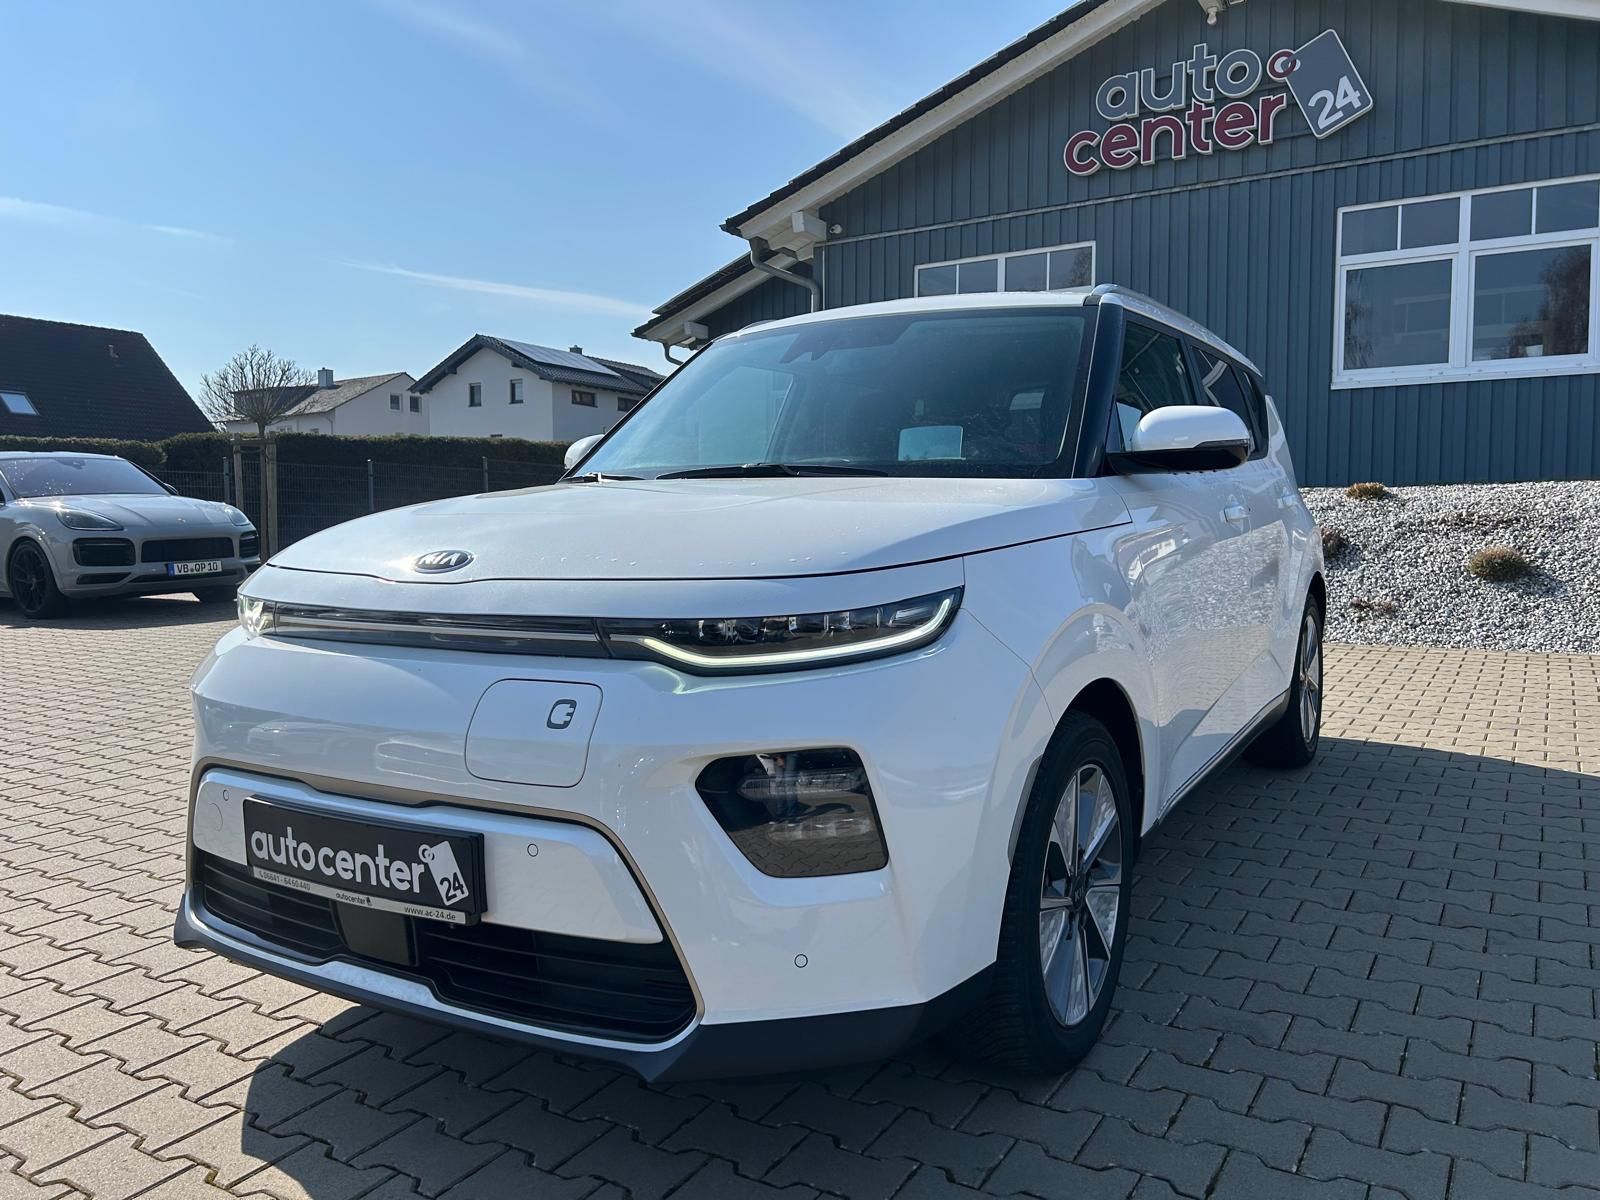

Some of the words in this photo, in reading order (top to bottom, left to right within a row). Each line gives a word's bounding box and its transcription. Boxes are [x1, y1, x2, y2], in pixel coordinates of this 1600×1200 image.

[1095, 43, 1262, 121] auto
[1307, 75, 1362, 130] 24
[1063, 93, 1287, 176] center
[177, 564, 189, 573] VB
[208, 562, 218, 571] 10
[417, 551, 461, 566] KIA
[250, 826, 425, 894] autocenter
[439, 871, 465, 901] 24
[404, 906, 456, 921] www.ac-24.de
